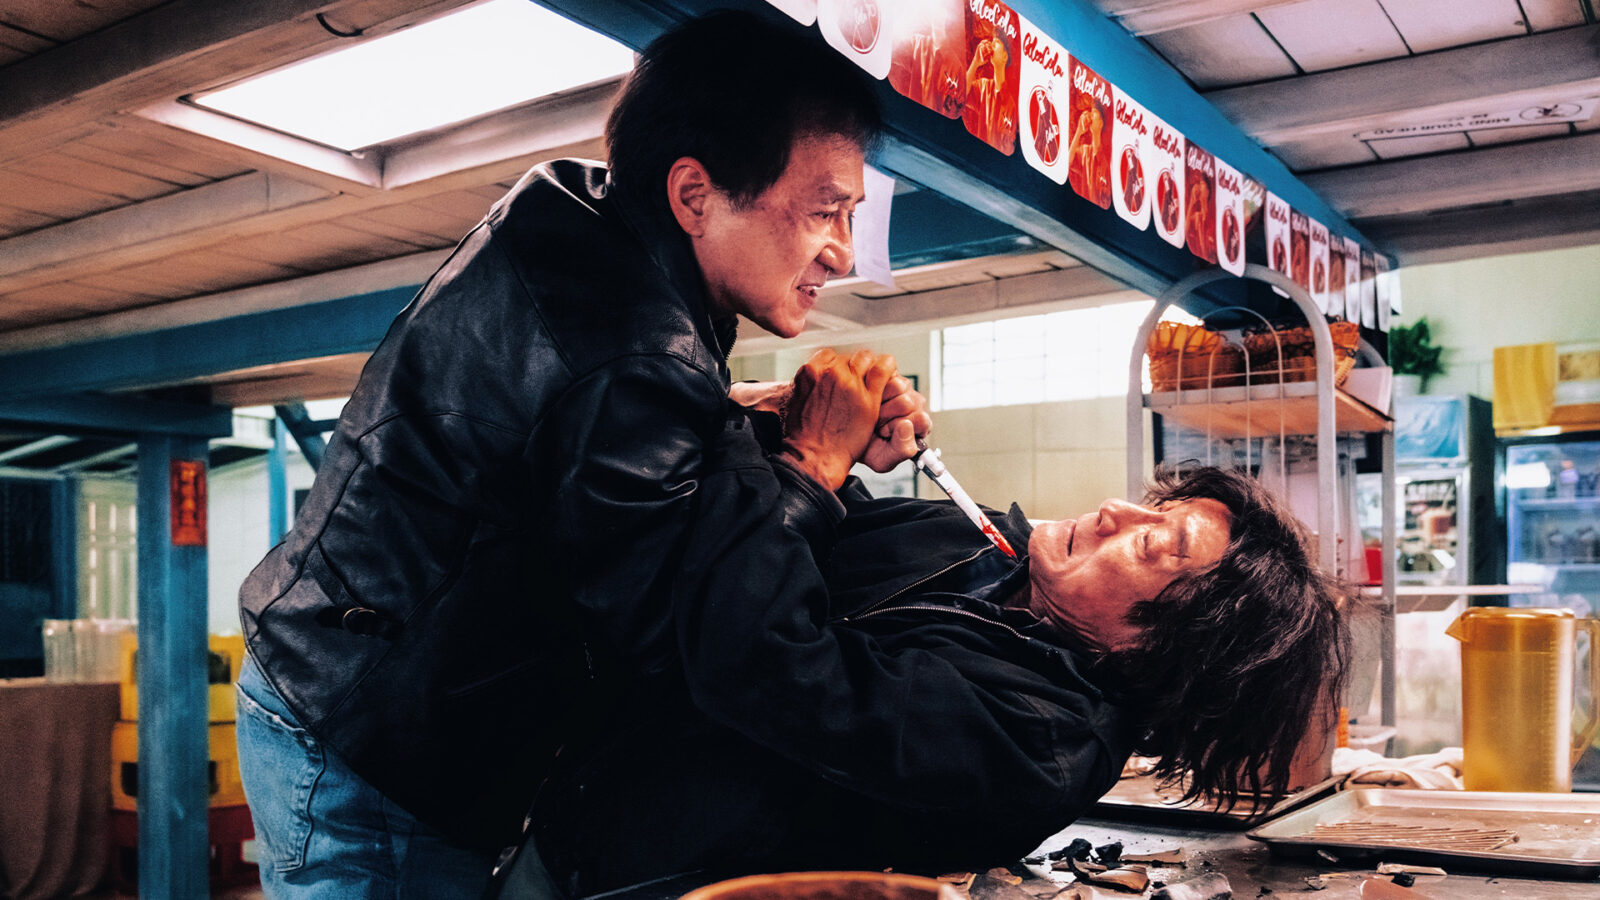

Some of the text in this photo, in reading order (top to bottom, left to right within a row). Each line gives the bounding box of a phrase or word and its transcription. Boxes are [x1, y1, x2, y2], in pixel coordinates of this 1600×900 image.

[1469, 117, 1511, 126] MIND
[1374, 126, 1417, 135] HEAD
[1421, 122, 1464, 131] YOUR
